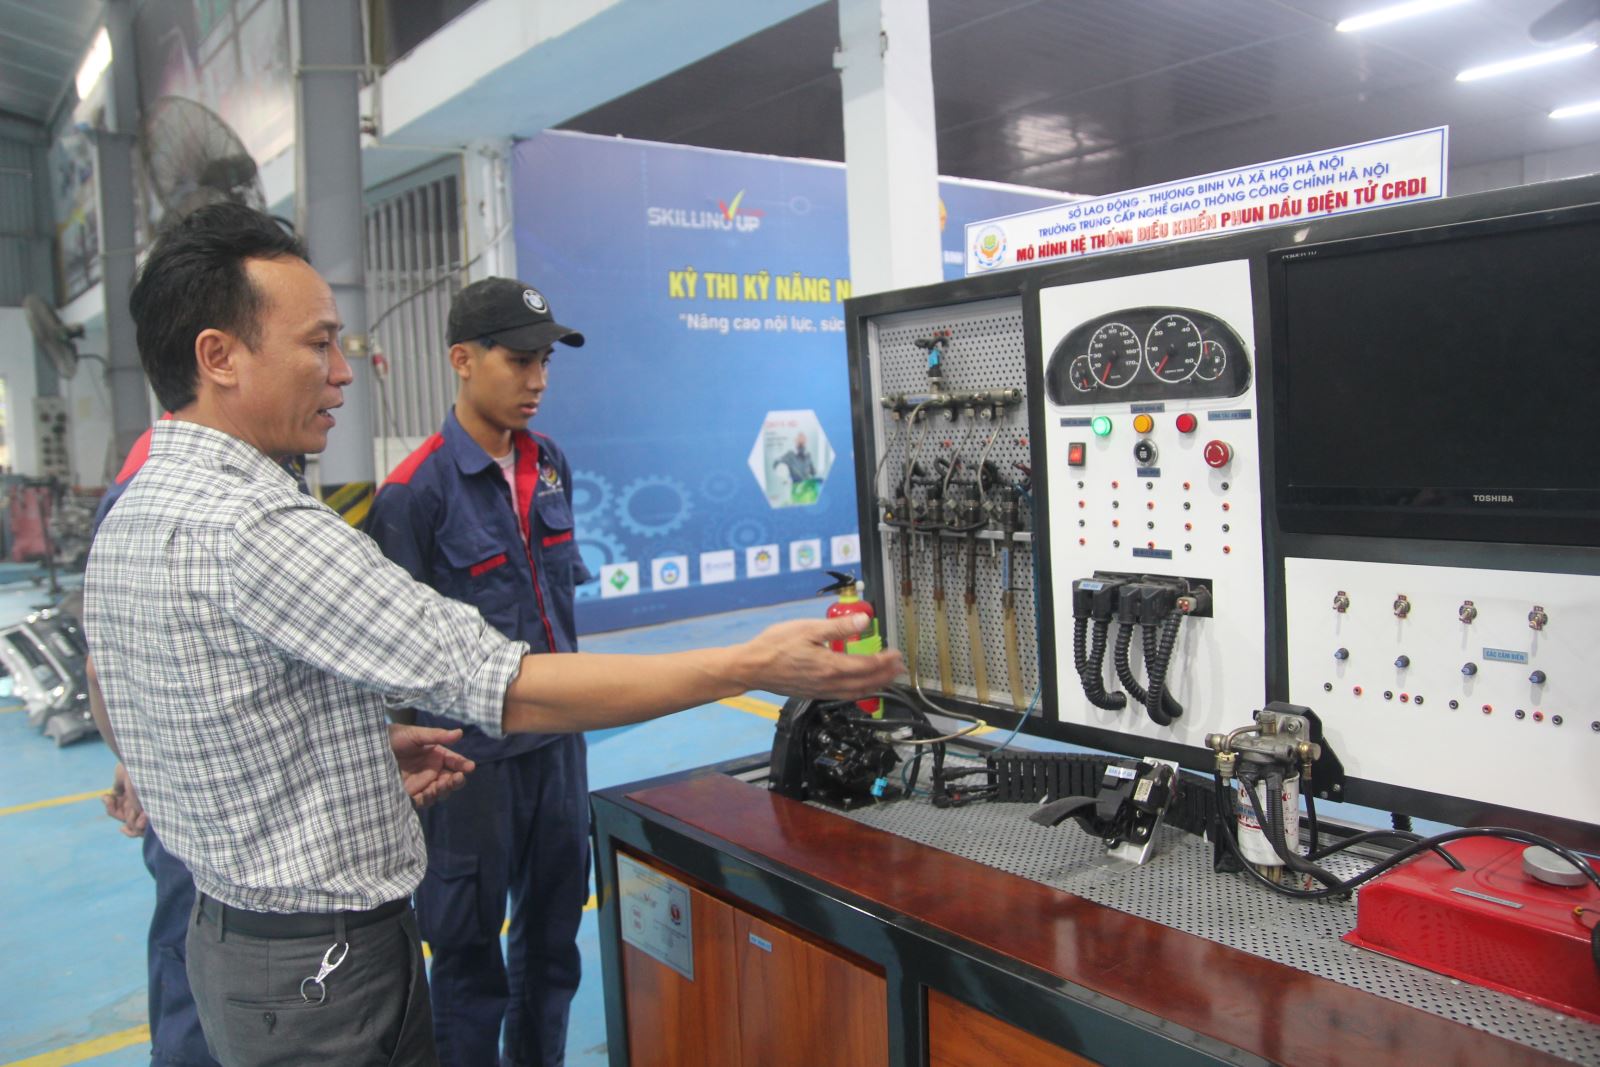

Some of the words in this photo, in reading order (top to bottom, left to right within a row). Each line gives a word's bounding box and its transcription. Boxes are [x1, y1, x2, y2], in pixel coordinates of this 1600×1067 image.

[1039, 222, 1076, 237] TRƯỜNG
[1080, 215, 1111, 230] TRUNG
[1114, 208, 1135, 223] CẤP
[1138, 202, 1168, 219] NGHỀ
[1170, 199, 1200, 213] GIAO
[1204, 190, 1246, 207] THÔNG
[1248, 182, 1289, 199] CÔNG
[1293, 173, 1335, 190] CHÍNH
[1339, 166, 1358, 182] HÀ
[1363, 162, 1389, 178] NỘI
[1068, 205, 1082, 220] SỞ
[1084, 204, 1104, 216] LAO
[1107, 197, 1139, 212] ĐỘNG
[1149, 186, 1195, 203] THƯƠNG
[1198, 180, 1224, 194] BINH
[1228, 174, 1244, 187] VÀ
[1249, 170, 1265, 184] XÃ
[1270, 165, 1292, 180] HỘI
[1296, 160, 1315, 175] HÀ
[1319, 155, 1344, 170] NỘI
[736, 215, 760, 231] UP
[1016, 244, 1034, 262] MÔ
[1038, 240, 1067, 258] HÌNH
[1070, 233, 1086, 255] HỆ
[1090, 227, 1133, 249] THỐNG
[1137, 219, 1169, 241] ĐIỀU
[1172, 209, 1216, 236] KHIỂN
[1221, 205, 1264, 227] PHUN
[1268, 195, 1302, 220] DẦU
[1307, 190, 1348, 213] ĐIỆN
[1354, 180, 1378, 205] TỬ
[1382, 176, 1427, 200] CRDI
[669, 266, 698, 299] KỲ
[703, 272, 738, 300] THI
[743, 269, 770, 301] KỸ
[776, 272, 831, 303] NĂNG
[733, 317, 761, 330] cao
[764, 314, 787, 332] nội
[1472, 494, 1514, 503] TOSHIBA
